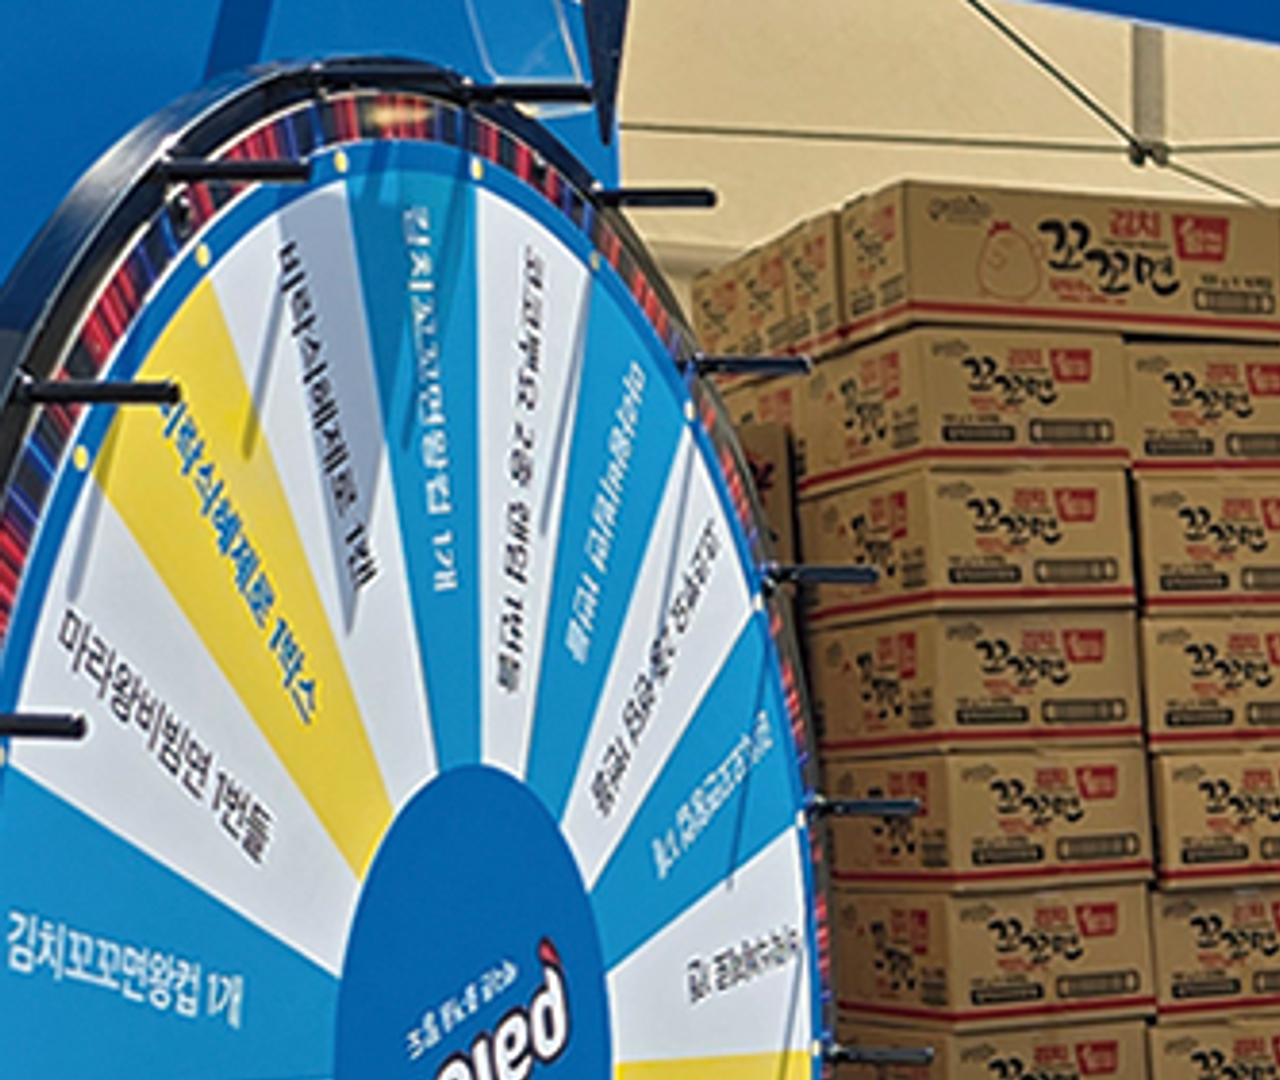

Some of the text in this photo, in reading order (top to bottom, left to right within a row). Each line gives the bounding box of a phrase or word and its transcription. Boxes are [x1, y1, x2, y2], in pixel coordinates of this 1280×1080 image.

[1038, 220, 1180, 297] 꼬꼬면
[278, 241, 376, 587] 비락식혜제로 1캔
[430, 529, 459, 592] 1개
[58, 608, 270, 862] 마라왕비빔면 1번들
[6, 910, 247, 1030] 김치꼬꼬면왕컵 1개
